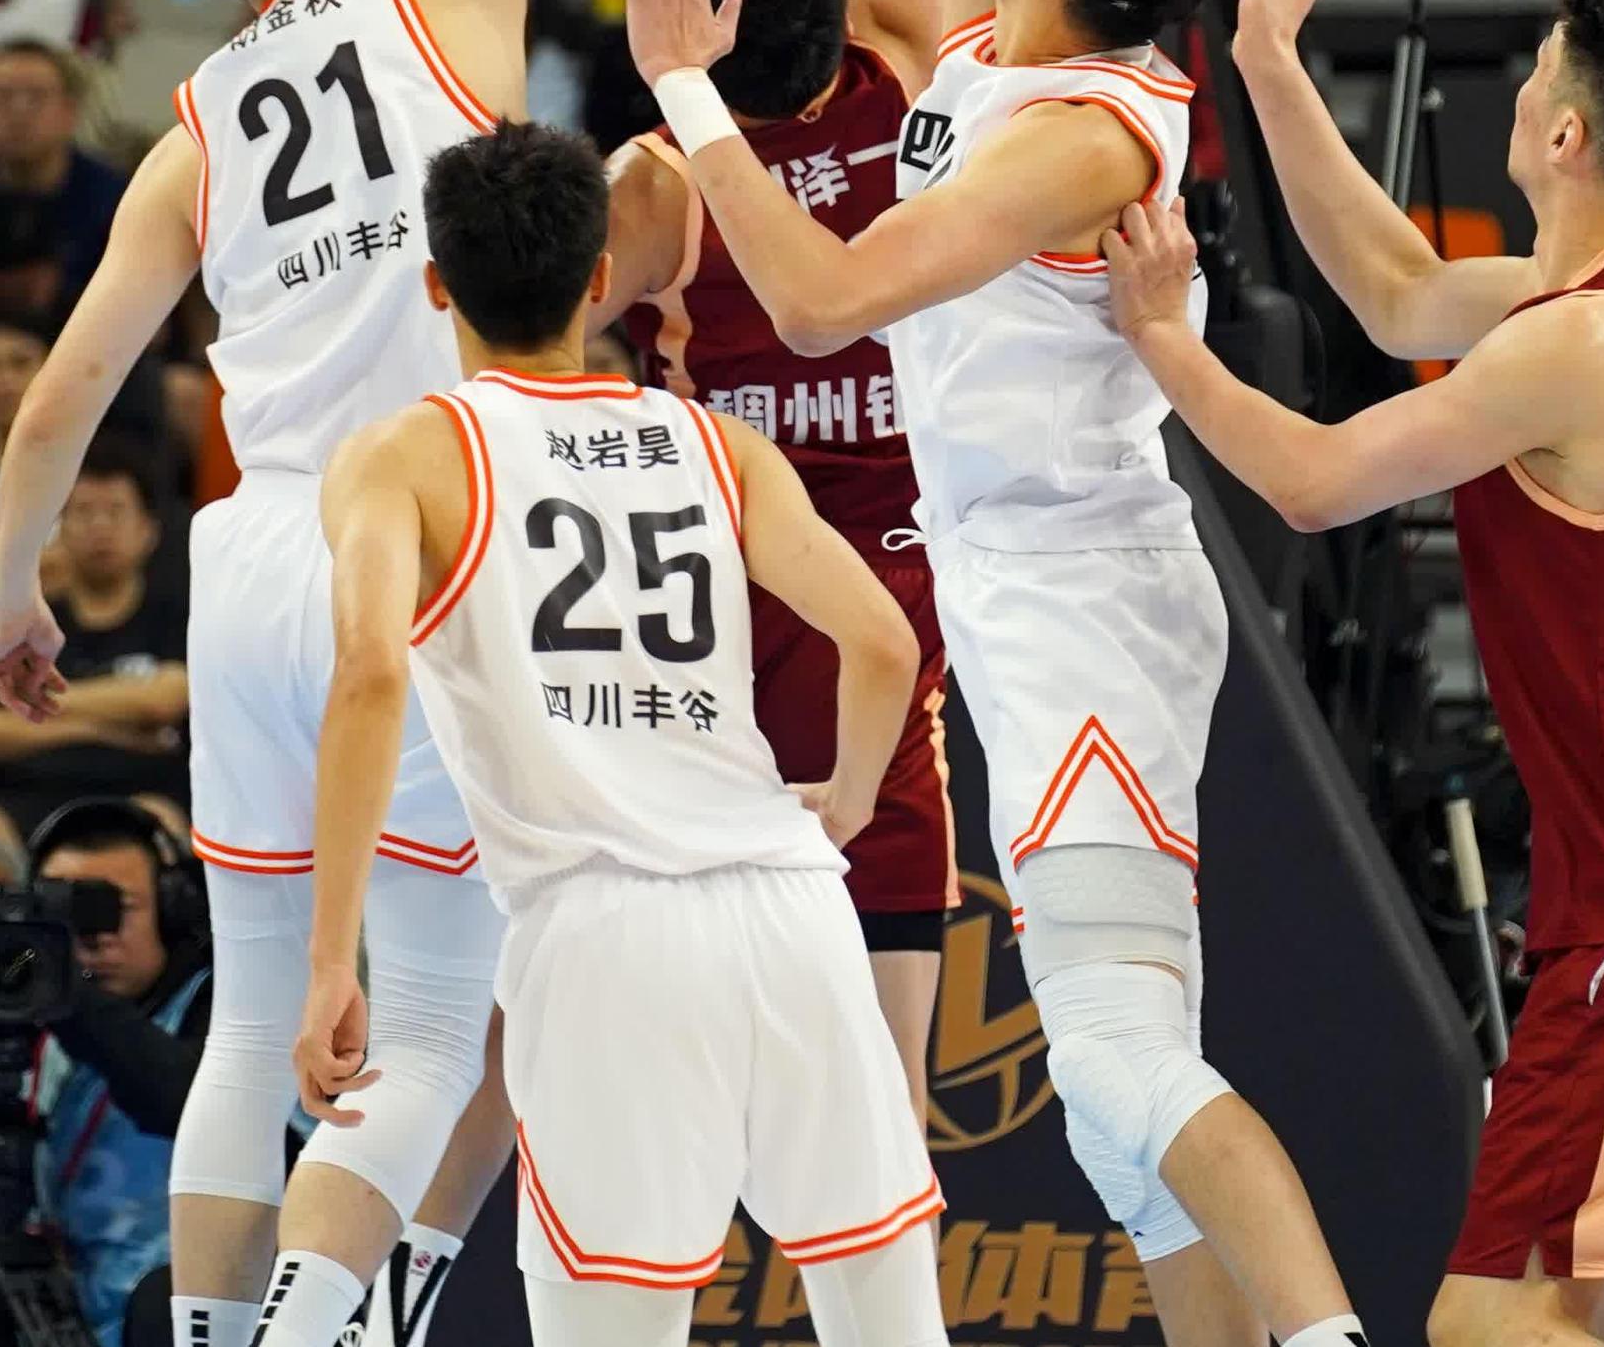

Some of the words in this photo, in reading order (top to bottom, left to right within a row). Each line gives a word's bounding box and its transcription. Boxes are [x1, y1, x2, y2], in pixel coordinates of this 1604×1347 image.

[238, 40, 395, 227] 21
[769, 141, 898, 214] 泽一
[277, 209, 409, 289] 四川丰谷
[545, 424, 680, 471] 赵岩昊
[525, 497, 716, 663] 25
[541, 682, 719, 733] 四川丰谷
